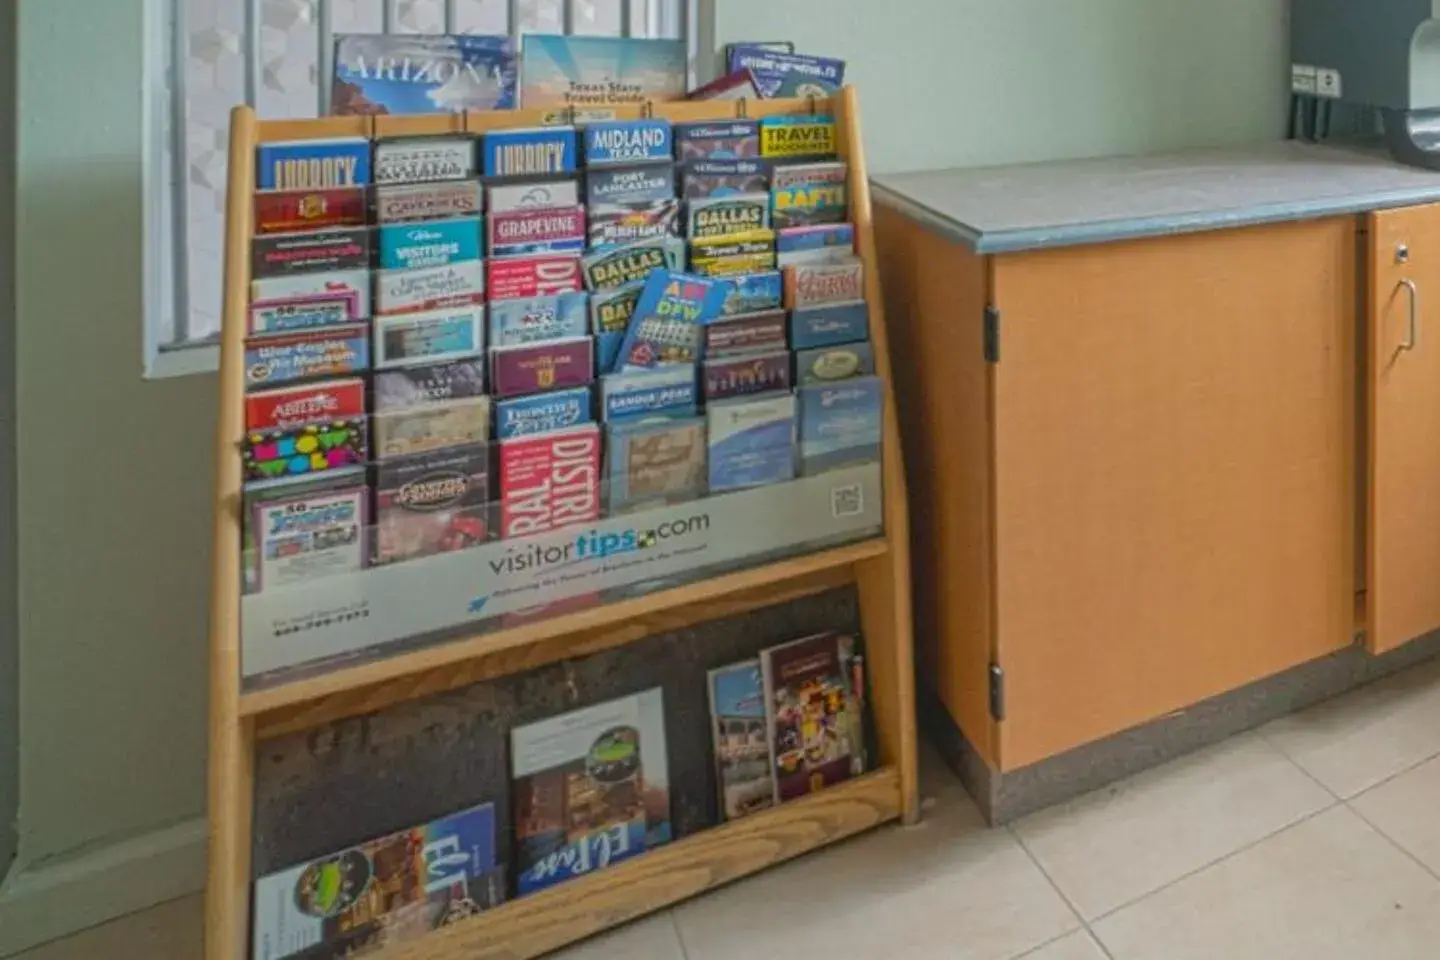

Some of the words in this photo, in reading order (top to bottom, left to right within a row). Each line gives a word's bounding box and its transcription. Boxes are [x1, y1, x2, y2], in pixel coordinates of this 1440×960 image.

[345, 54, 507, 89] ARIZONA
[568, 80, 606, 93] Texas
[608, 81, 643, 93] State
[563, 92, 606, 104] Travel
[594, 127, 665, 150] MIDLAND
[767, 126, 832, 142] TRAVEL
[698, 207, 761, 226] DALLAS
[498, 216, 577, 238] GRAPEVINE
[592, 249, 663, 282] DALLAS
